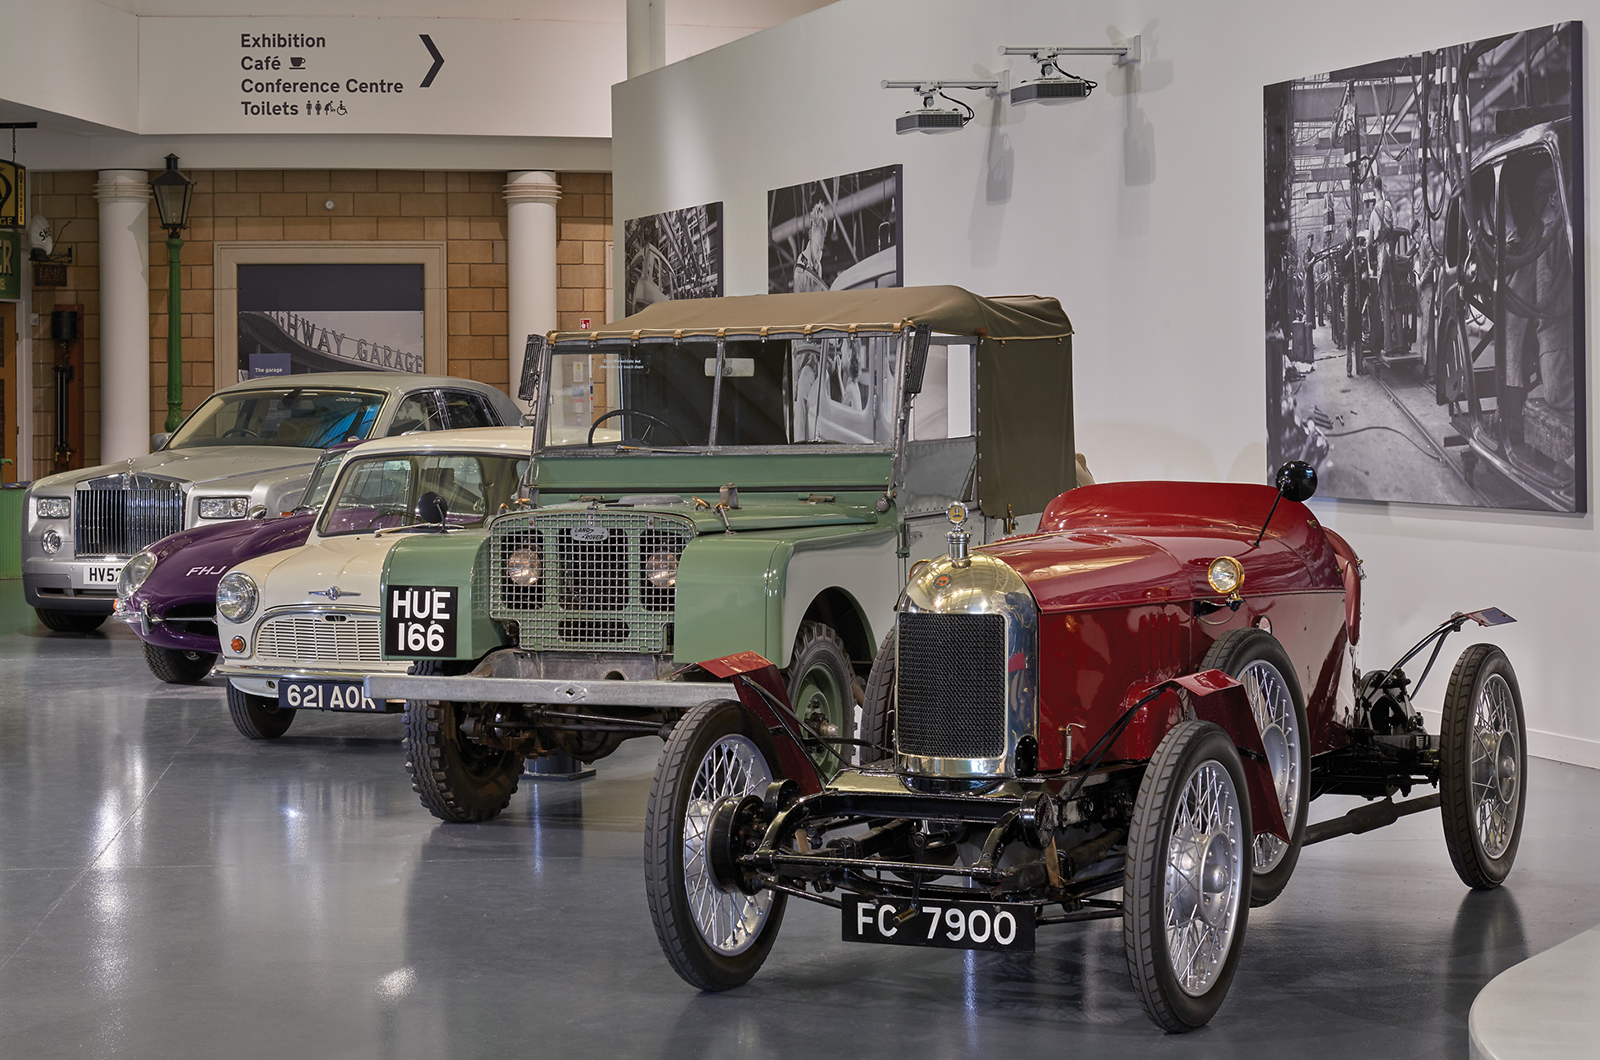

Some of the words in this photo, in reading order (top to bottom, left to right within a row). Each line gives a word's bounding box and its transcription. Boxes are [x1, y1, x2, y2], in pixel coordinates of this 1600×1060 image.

[240, 33, 326, 48] Exhibition
[240, 55, 282, 71] Café
[240, 78, 340, 93] Conference
[345, 78, 404, 93] Centre
[240, 101, 299, 116] Toilets
[357, 338, 423, 374] GARAGE
[185, 565, 227, 577] FHJ
[392, 590, 451, 620] HUE
[398, 622, 445, 652] 166
[287, 684, 323, 708] 621
[857, 902, 898, 938] FC
[922, 906, 1017, 945] 7900
